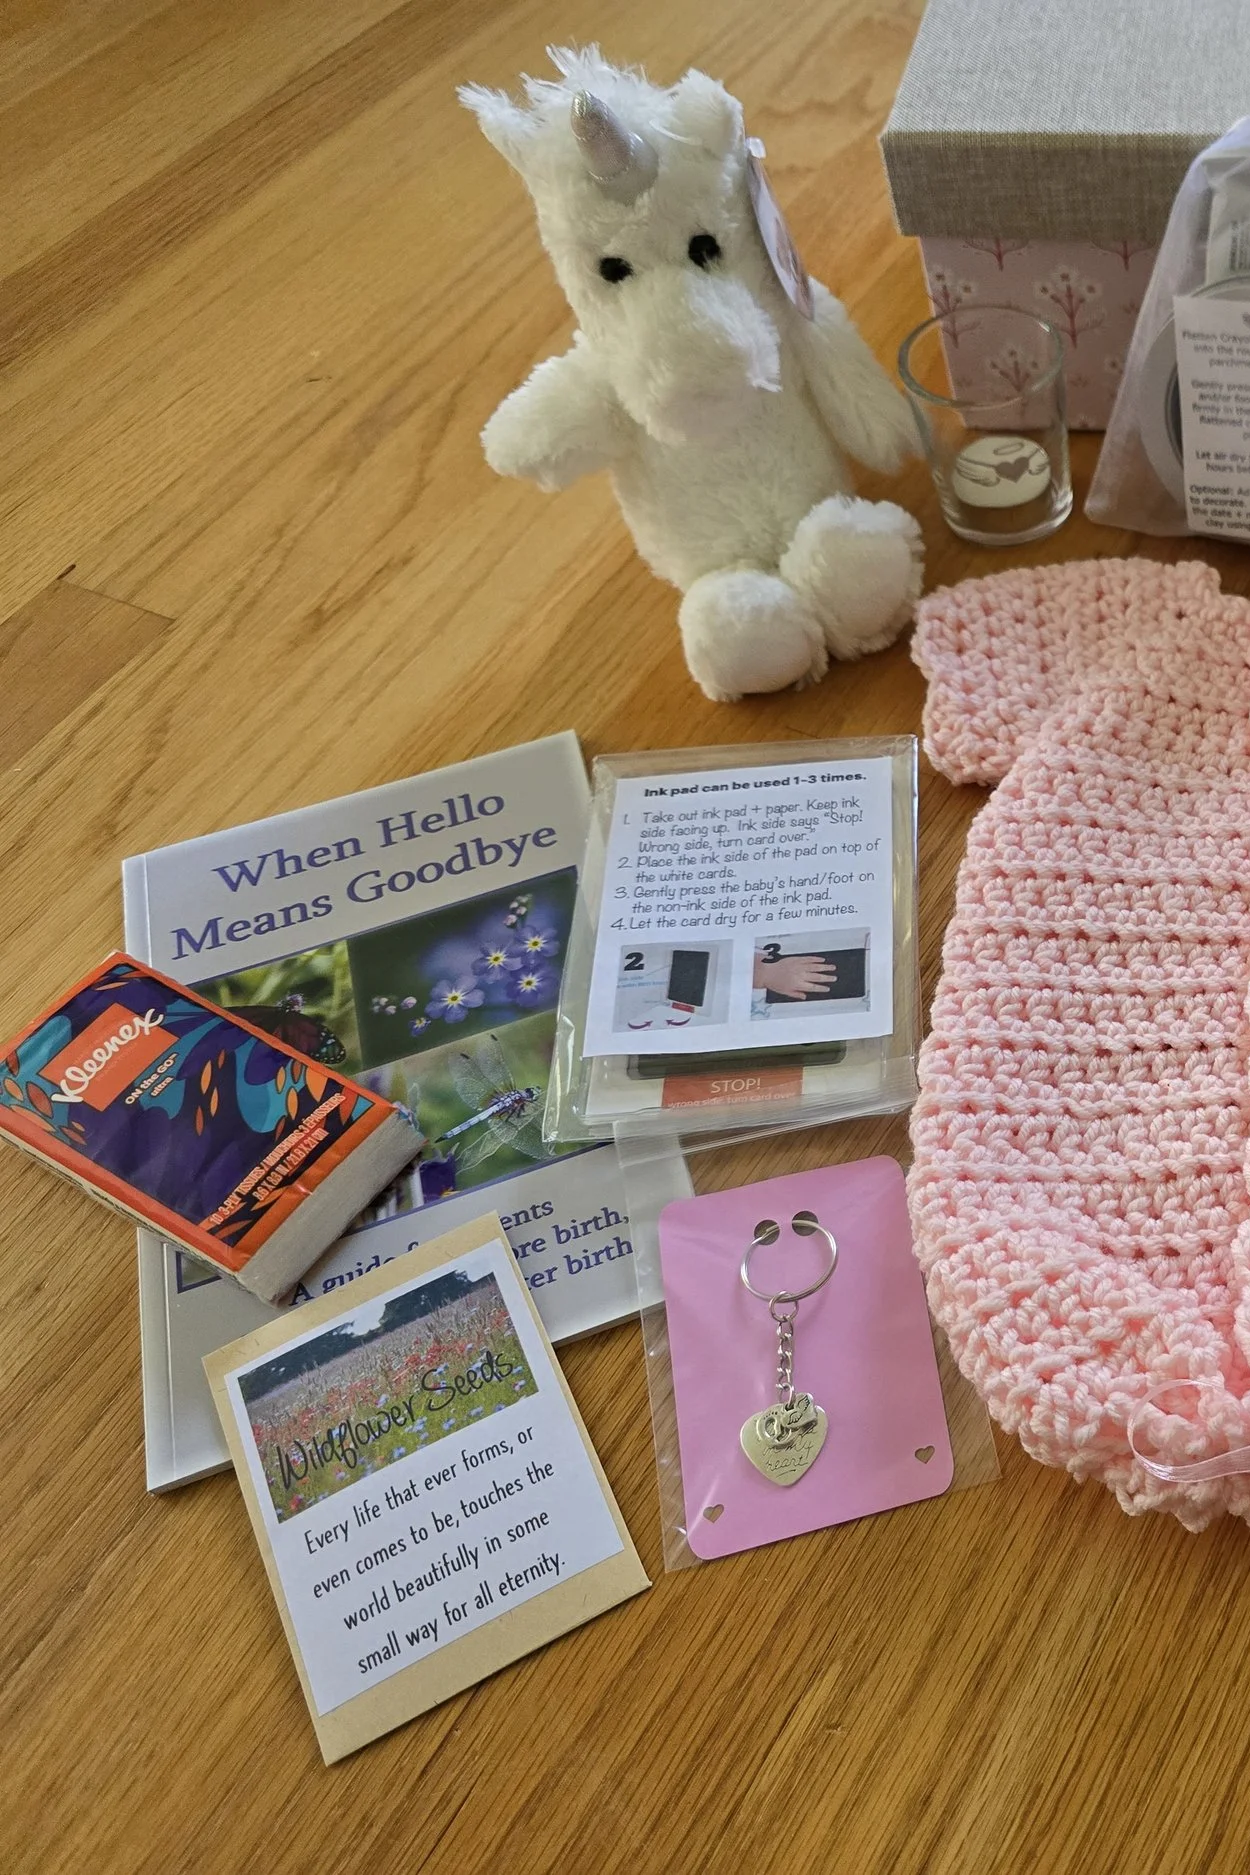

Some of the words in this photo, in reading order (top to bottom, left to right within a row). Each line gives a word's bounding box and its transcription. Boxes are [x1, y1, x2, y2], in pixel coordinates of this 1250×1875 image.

[644, 786, 668, 797] Ink
[670, 785, 698, 797] pad
[702, 783, 729, 792] can
[732, 782, 750, 790] be
[754, 777, 790, 788] used
[821, 773, 867, 783] times.
[643, 811, 674, 823] Take
[678, 810, 698, 822] out
[702, 809, 721, 819] ink
[725, 804, 747, 819] pad
[766, 803, 803, 818] paper.
[807, 799, 838, 813] Keep
[842, 796, 860, 808] ink
[640, 825, 666, 838] side
[670, 824, 709, 837] facing
[713, 825, 730, 837] up.
[738, 820, 757, 831] Ink
[762, 818, 786, 830] side
[790, 816, 819, 830] says
[211, 837, 366, 894] When
[376, 792, 505, 849] Hello
[637, 855, 673, 868] Place
[678, 855, 697, 866] the
[701, 853, 720, 865] ink
[724, 851, 749, 863] side
[753, 848, 769, 861] of
[772, 847, 791, 859] the
[795, 844, 818, 860] pad
[822, 844, 837, 855] on
[842, 843, 862, 856] top
[866, 838, 881, 851] of
[639, 841, 680, 854] Wrong
[684, 839, 713, 851] side,
[718, 837, 743, 848] turn
[747, 834, 775, 846] card
[614, 886, 630, 899] 3.
[634, 885, 676, 900] Gently
[680, 884, 716, 899] press
[721, 881, 740, 893] the
[745, 876, 785, 893] baby's
[789, 872, 854, 888] hand/foot
[859, 872, 875, 882] on
[636, 871, 655, 882] the
[659, 870, 694, 882] white
[698, 867, 737, 879] cards.
[169, 894, 333, 961] Means
[345, 826, 558, 904] Goodbye
[632, 902, 652, 913] the
[656, 900, 705, 913] non-ink
[710, 898, 736, 910] side
[740, 894, 757, 908] of
[759, 894, 779, 906] the
[783, 891, 802, 904] ink
[806, 888, 832, 905] pad.
[611, 918, 627, 930] 4.
[629, 917, 650, 930] Let
[657, 916, 676, 928] the
[681, 913, 710, 927] card
[715, 913, 737, 928] dry
[742, 909, 761, 923] for
[765, 913, 774, 921] a
[778, 907, 802, 920] few
[806, 904, 858, 917] minutes.
[624, 952, 645, 971] 2
[761, 943, 781, 964] 3
[51, 1008, 164, 1103] Kleenex
[125, 1088, 143, 1105] ON
[140, 1073, 159, 1090] the
[151, 1075, 174, 1097] ultra
[710, 1078, 761, 1094] STOP!
[209, 1213, 224, 1225] 10
[237, 1166, 266, 1195] TISSUES
[551, 1207, 629, 1244] birth,
[563, 1236, 633, 1275] birth
[288, 1280, 315, 1307] A
[322, 1255, 397, 1295] guid
[276, 1394, 417, 1492] Wildflower
[421, 1350, 514, 1412] Seeds
[304, 1518, 350, 1555] Every
[353, 1499, 382, 1528] life
[384, 1478, 421, 1512] that
[423, 1463, 457, 1491] ever
[461, 1438, 514, 1473] forms,
[517, 1425, 534, 1445] or
[312, 1571, 351, 1599] even
[356, 1540, 407, 1575] comes
[409, 1523, 429, 1546] to
[430, 1511, 460, 1534] be,
[460, 1476, 524, 1519] touches
[526, 1460, 555, 1486] the
[343, 1585, 392, 1631] world
[393, 1543, 480, 1603] beautifully
[485, 1535, 503, 1556] in
[506, 1510, 550, 1543] some
[357, 1630, 401, 1674] small
[405, 1618, 440, 1648] way
[443, 1601, 469, 1626] for
[475, 1581, 495, 1611] all
[498, 1551, 567, 1597] eternity.
